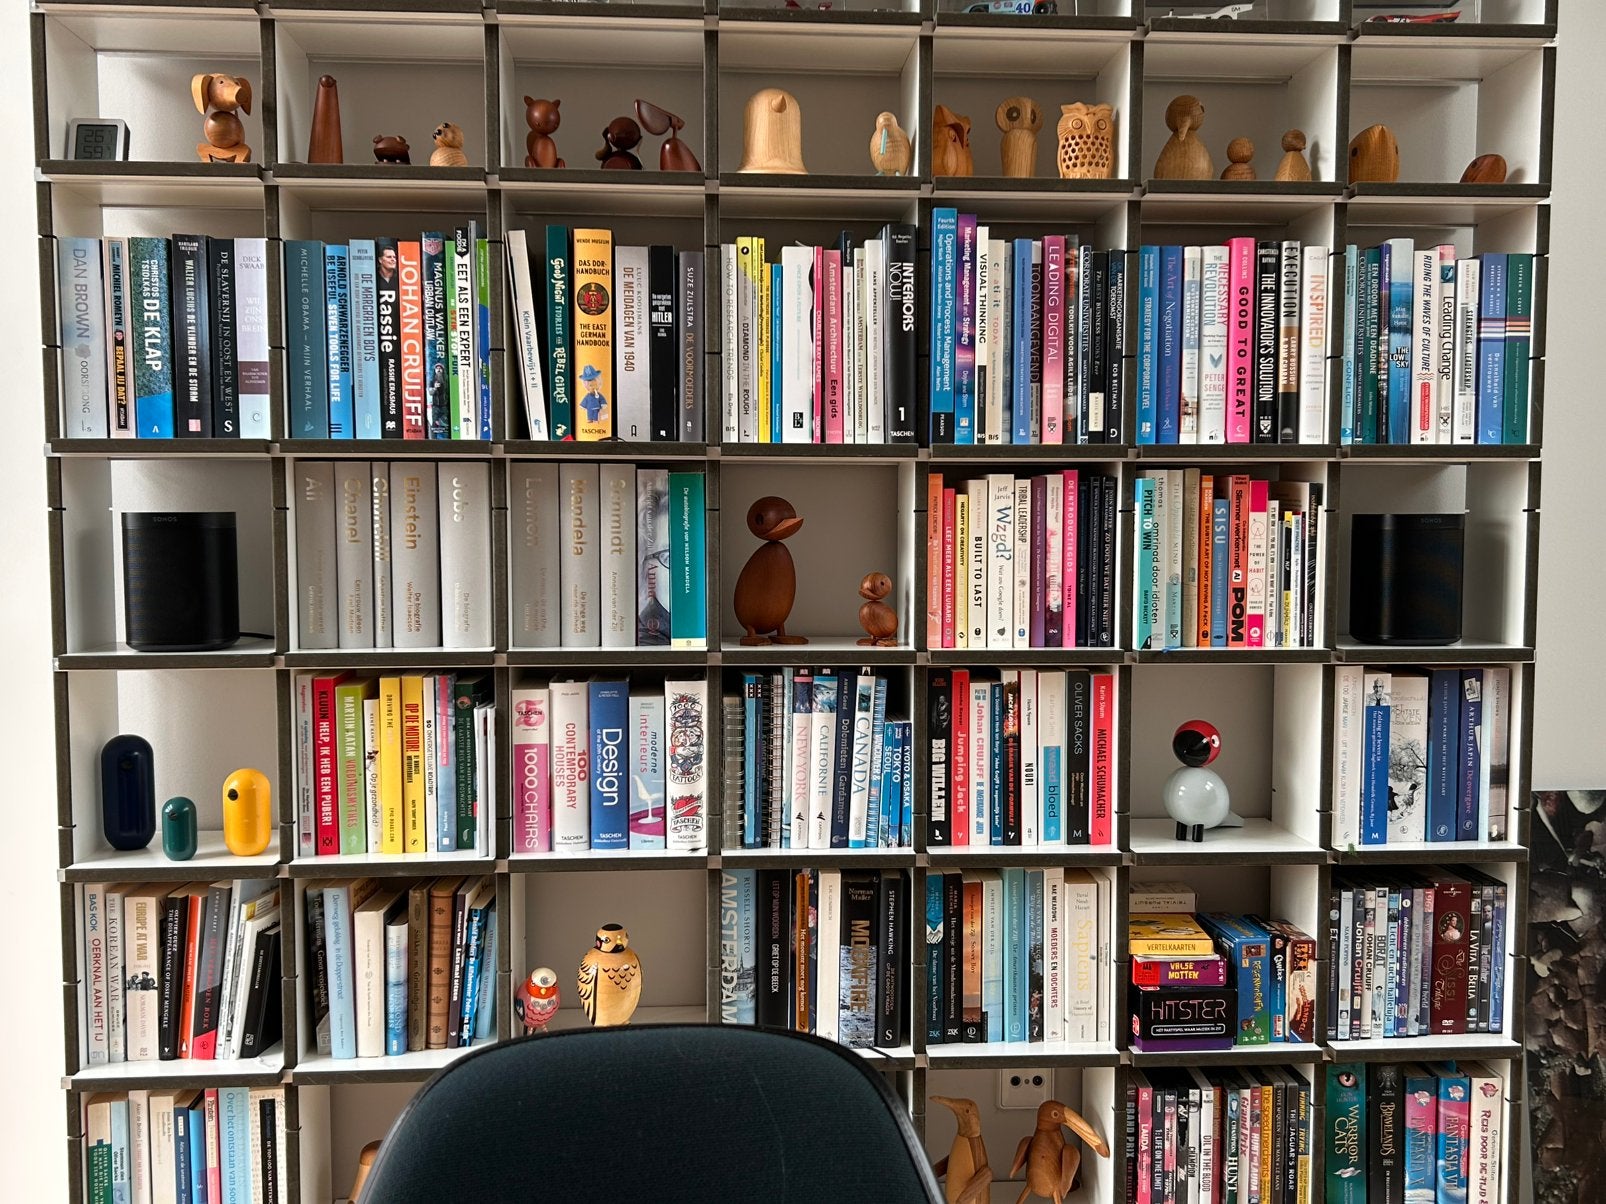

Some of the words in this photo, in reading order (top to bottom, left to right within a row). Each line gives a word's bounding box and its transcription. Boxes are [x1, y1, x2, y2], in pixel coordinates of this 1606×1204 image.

[1015, 2, 1031, 14] 40
[84, 129, 103, 143] 26
[73, 247, 88, 278] DAN
[623, 267, 635, 280] DE
[942, 233, 954, 287] Operations
[979, 253, 988, 291] VISUAL
[1370, 263, 1378, 277] EEN
[1422, 254, 1432, 283] RIDING
[142, 259, 151, 297] TSIOLKAS
[151, 259, 160, 297] CHRISTOS
[361, 273, 372, 284] DE
[433, 262, 443, 308] MAGNUS
[828, 262, 838, 314] Amsterdam
[889, 262, 902, 301] NOW!
[1047, 246, 1060, 305] LEADING
[1282, 246, 1299, 318] EXECUTION
[401, 255, 419, 333] JOHAN
[624, 281, 635, 326] MEIDAGEN
[902, 262, 915, 331] INTERIORS
[943, 288, 953, 299] and
[1370, 278, 1378, 306] DROOM
[1422, 284, 1431, 299] THE
[74, 283, 91, 339] BROWN
[143, 298, 161, 321] DE
[362, 286, 374, 336] MARGRATEN
[379, 290, 397, 352] Rassie
[943, 300, 953, 334] Process
[979, 293, 988, 343] THINKING
[1144, 297, 1153, 326] STRATEGY
[1237, 286, 1249, 328] GOOD
[1370, 308, 1378, 323] MET
[1421, 299, 1431, 325] WAVES
[1440, 296, 1454, 338] Leading
[435, 312, 445, 358] WALKER
[624, 330, 635, 348] VAN
[686, 332, 695, 344] DE
[829, 317, 840, 374] Architectuur
[1047, 313, 1060, 363] DIGITAL
[1144, 327, 1152, 340] FOR
[1370, 324, 1378, 339] EEN
[1421, 326, 1431, 338] OF
[145, 326, 163, 371] KLAP
[364, 339, 376, 361] BOYS
[625, 350, 636, 371] 1940
[1143, 341, 1152, 354] THE
[1236, 338, 1248, 358] TO
[1369, 340, 1378, 374] DEADLINE
[1421, 338, 1431, 371] CULTURE
[1438, 341, 1453, 380] Change
[685, 346, 695, 409] VOORMOEDERS
[942, 335, 952, 391] Management
[1142, 354, 1152, 385] CORPORATE
[403, 339, 422, 425] CRUIJFF
[830, 379, 840, 395] Een
[1235, 366, 1247, 417] GREAT
[828, 398, 840, 418] gids
[1142, 386, 1150, 409] LEVEL
[343, 478, 362, 543] Chanel
[404, 476, 422, 549] Einstein
[570, 479, 588, 555] Mandela
[1143, 489, 1153, 515] PITCH
[1235, 489, 1243, 521] Slimmer
[960, 527, 966, 536] ON
[1143, 517, 1152, 530] TO
[1234, 522, 1242, 551] werken
[974, 536, 983, 563] BUILT
[1143, 531, 1152, 550] WIN
[974, 568, 983, 581] TO
[1233, 552, 1241, 568] met
[973, 584, 982, 608] LAST
[1232, 586, 1245, 641] POM
[318, 690, 328, 719] KLUUN
[344, 696, 356, 729] MARTIJN
[404, 702, 418, 714] OP
[1073, 681, 1082, 718] OLIVER
[318, 721, 328, 743] HELP,
[405, 714, 418, 725] DE
[1467, 705, 1476, 741] ARTHUR
[319, 746, 328, 755] IK
[345, 731, 356, 757] KATAN
[405, 725, 420, 752] MOTOR!
[796, 725, 808, 760] NEW
[931, 738, 945, 762] BIG
[1073, 720, 1083, 755] SACKS
[319, 757, 329, 774] HEB
[523, 746, 539, 789] 1000
[555, 745, 566, 787] HOUSES
[565, 722, 577, 808] CONTEMPORARY
[577, 749, 588, 781] 100
[597, 727, 623, 805] Design
[817, 724, 830, 796] CALIFORNIE
[852, 716, 870, 794] CANADA
[892, 746, 902, 782] TOKYO
[954, 730, 967, 782] Jumping
[1466, 742, 1475, 767] JAPIN
[320, 776, 330, 792] EEN
[795, 761, 807, 800] YORK
[1024, 762, 1034, 785] NOURI
[931, 763, 946, 821] WILLEM
[956, 784, 967, 813] Jack
[321, 794, 332, 826] PUBER!
[524, 790, 540, 848] CHAIRS
[88, 893, 98, 911] BAS
[743, 876, 752, 914] RUSSELL
[887, 890, 896, 920] STEPHEN
[89, 912, 99, 932] KOK
[135, 901, 148, 931] EUROPE
[136, 932, 148, 944] AT
[743, 916, 752, 953] SHORTO
[887, 922, 895, 955] HAWKING
[1146, 943, 1197, 952] VERTELKAARTEN
[1355, 920, 1363, 956] Johan
[1389, 925, 1397, 945] Licht
[92, 938, 103, 986] OERKNAL
[137, 943, 149, 961] WAR
[849, 919, 870, 1013] MOONFIRE
[1051, 961, 1059, 972] EN
[1071, 918, 1093, 992] Sapiens
[1169, 961, 1195, 970] VALSE
[1389, 948, 1396, 960] en
[1167, 969, 1200, 980] MOTTEN
[1353, 958, 1364, 994] Cruijff
[1388, 961, 1396, 984] Lucht
[92, 987, 104, 1008] AAN
[1050, 971, 1059, 1009] DOCHTERS
[1386, 986, 1396, 1021] halleluja
[93, 1009, 104, 1030] HET
[1151, 1000, 1226, 1020] HITSTER
[94, 1032, 104, 1043] IJ
[225, 1091, 236, 1114] Over
[1263, 1089, 1272, 1104] the
[226, 1115, 236, 1130] het
[1260, 1105, 1271, 1134] speed
[1348, 1103, 1360, 1165] WARRIOR
[1379, 1101, 1397, 1156] BRAVELANDS
[226, 1130, 237, 1169] ontstaan
[1141, 1123, 1149, 1151] LAUDA
[1334, 1116, 1350, 1154] CATS
[1262, 1134, 1271, 1178] merchants
[227, 1169, 236, 1185] van
